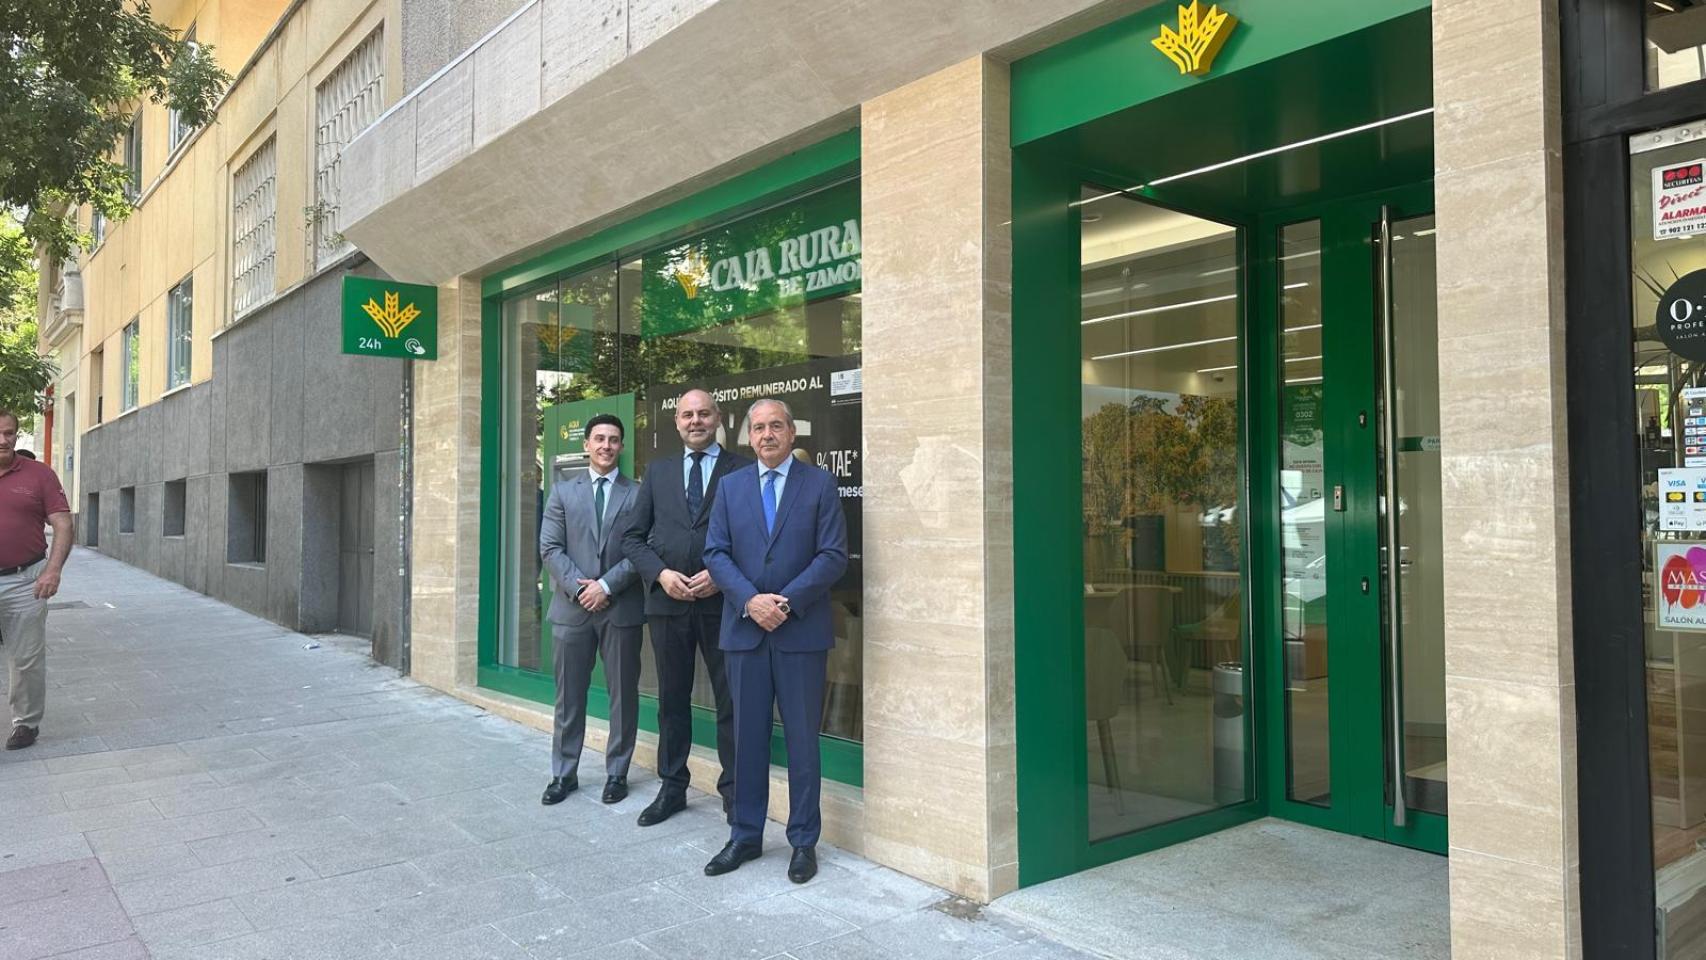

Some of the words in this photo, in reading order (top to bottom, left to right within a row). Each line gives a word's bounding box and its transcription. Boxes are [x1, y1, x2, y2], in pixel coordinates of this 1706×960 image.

[711, 247, 774, 291] CAJA
[359, 337, 382, 349] 24h
[661, 394, 680, 410] AQU
[740, 378, 807, 399] REMUNERADO
[809, 376, 824, 389] AL
